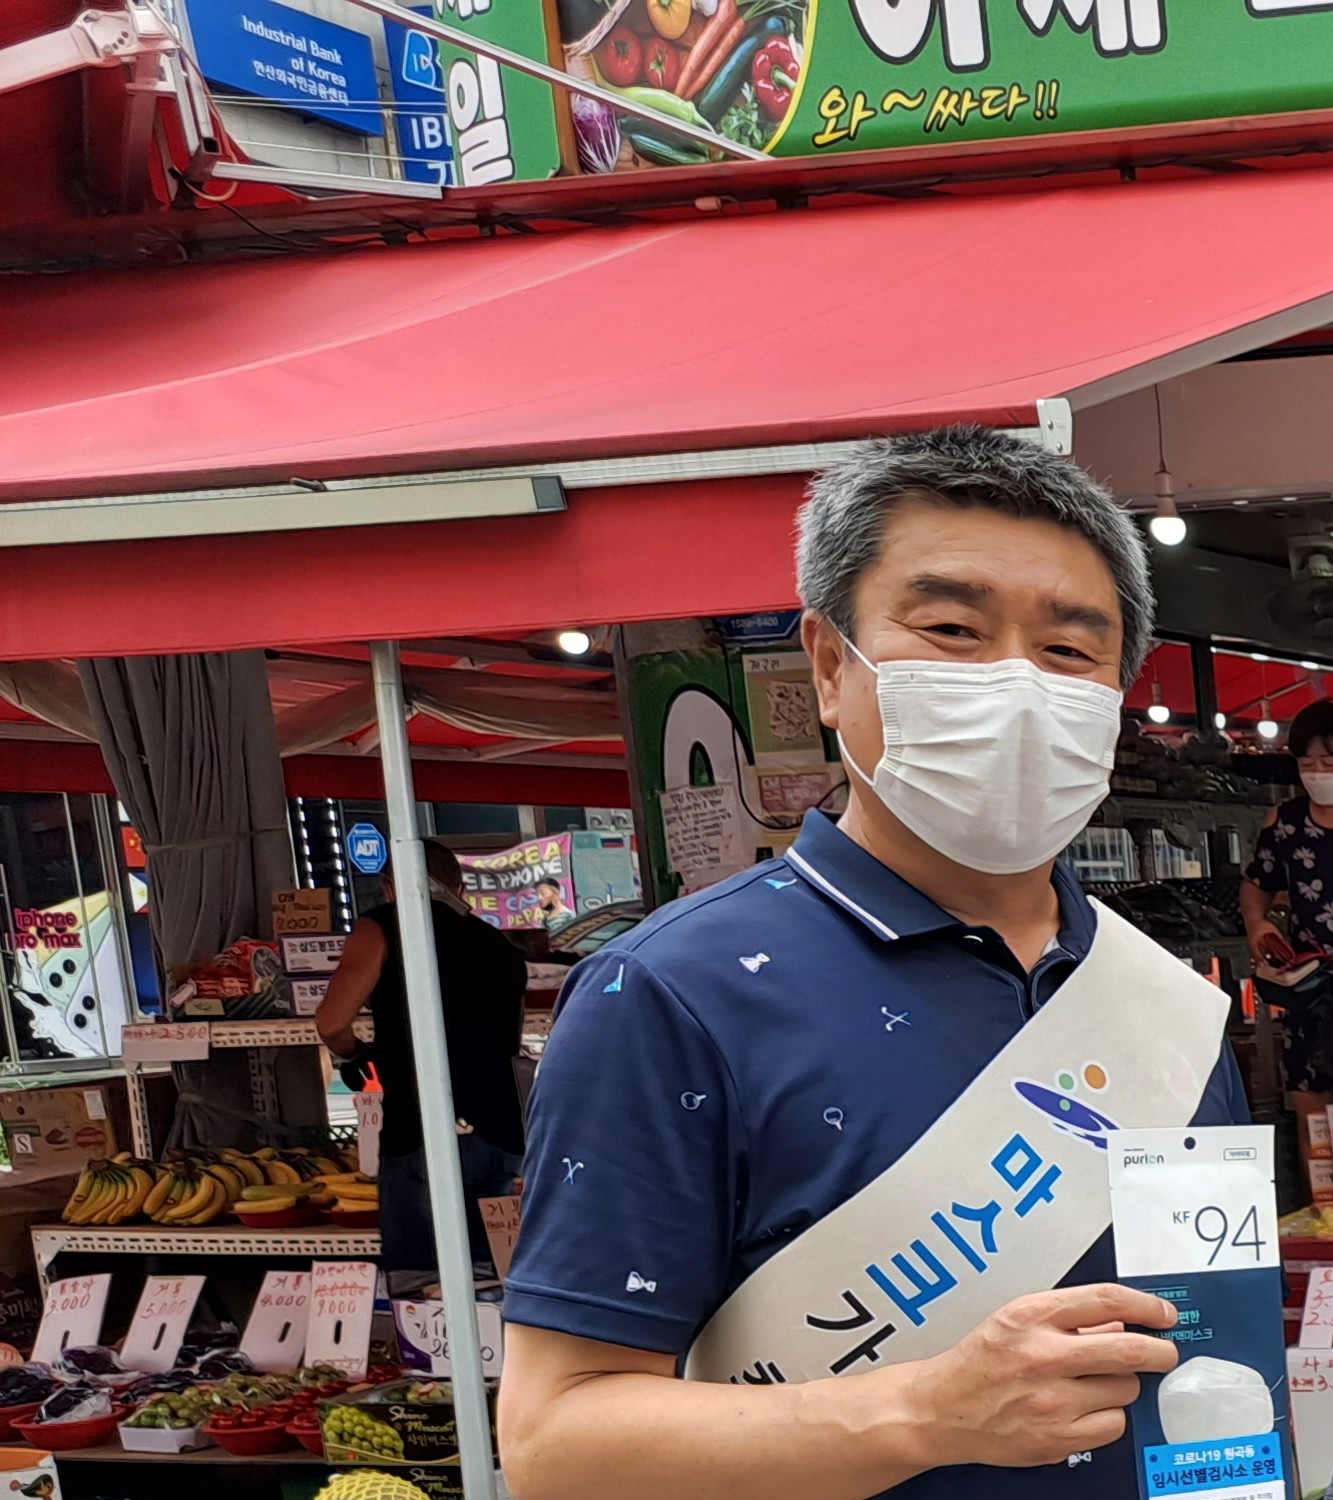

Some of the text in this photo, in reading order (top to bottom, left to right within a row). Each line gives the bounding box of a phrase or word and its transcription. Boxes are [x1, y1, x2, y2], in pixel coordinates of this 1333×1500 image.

[242, 15, 343, 66] Industrial Bank
[290, 56, 346, 88] of Korea
[355, 839, 379, 857] ADT
[44, 933, 82, 949] max
[1173, 1444, 1255, 1466] 코로나19 원곡동
[1152, 1458, 1277, 1489] 임시선별검사소 운영
